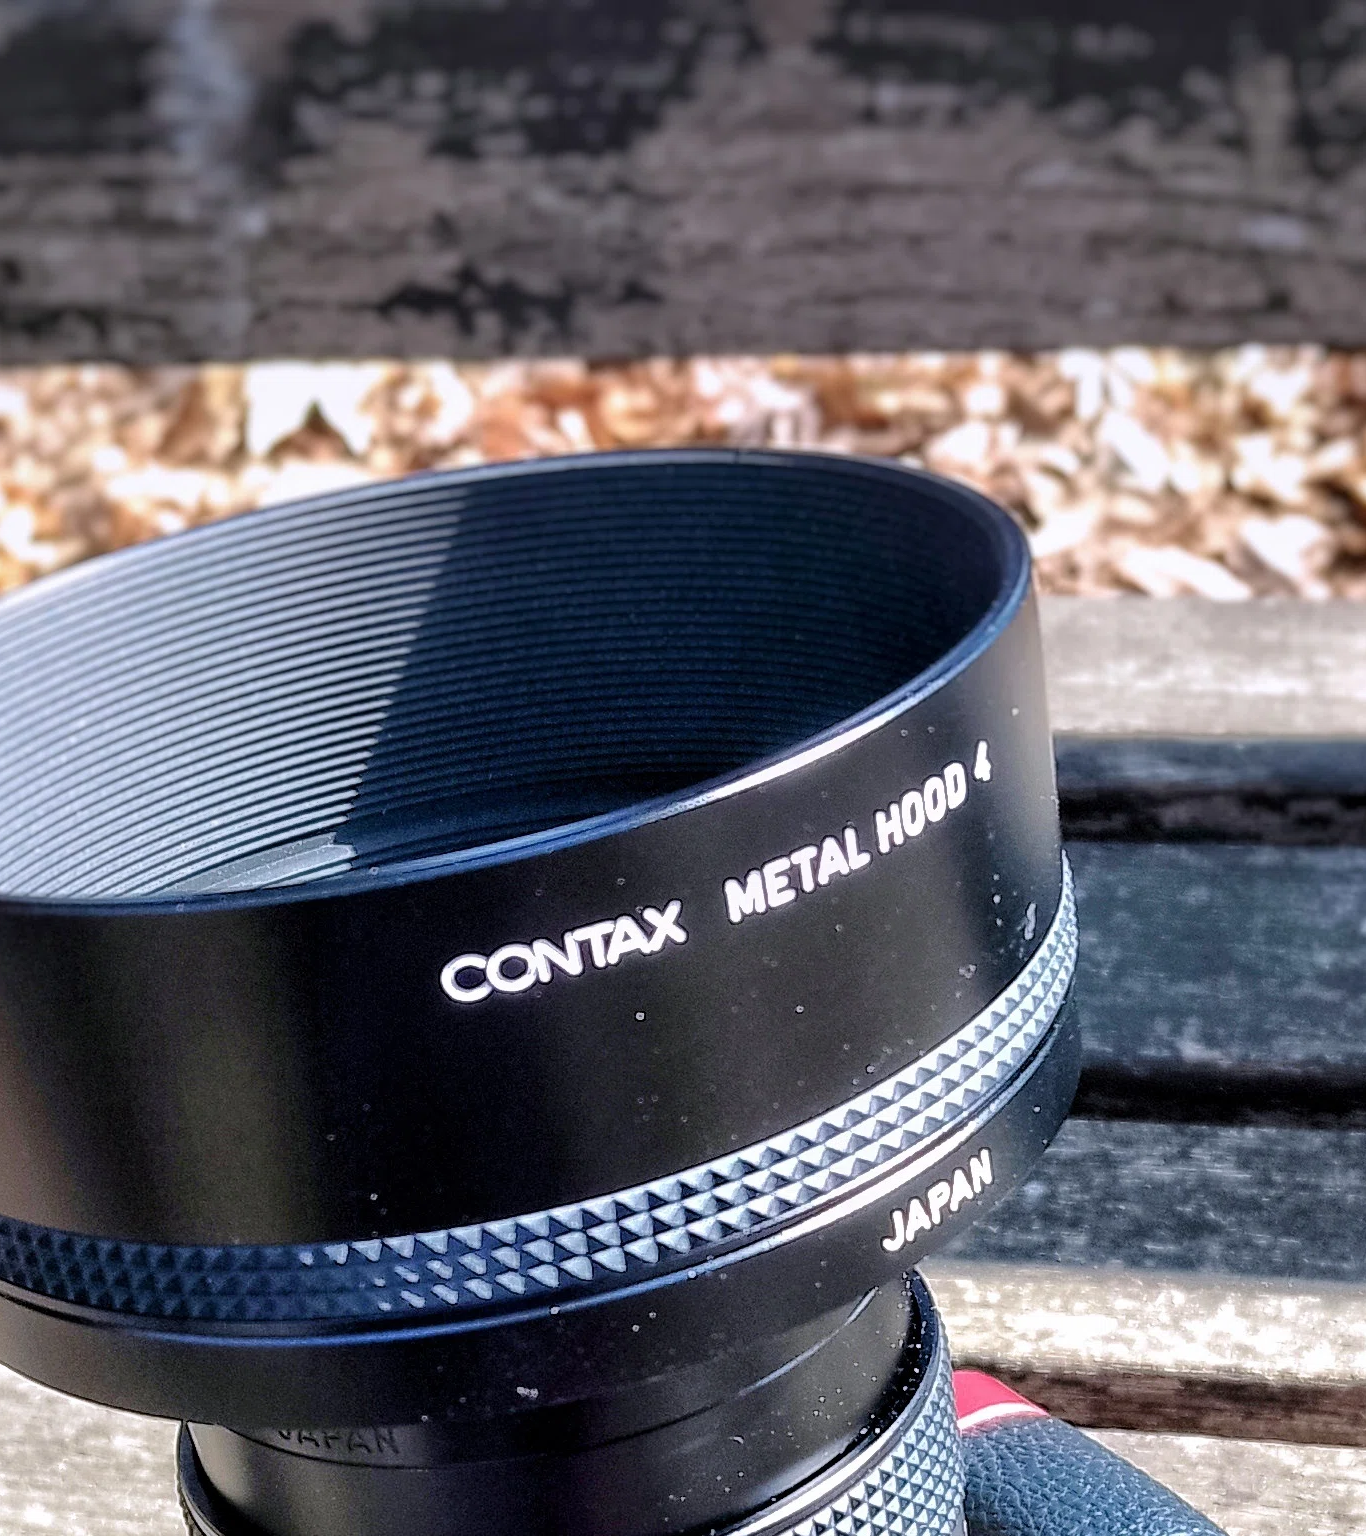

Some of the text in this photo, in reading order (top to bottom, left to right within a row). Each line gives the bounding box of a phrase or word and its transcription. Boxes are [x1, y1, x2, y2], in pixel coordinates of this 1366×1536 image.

[440, 739, 991, 1003] CONTAX METAL HOOD 4
[881, 1147, 994, 1252] JAPAN
